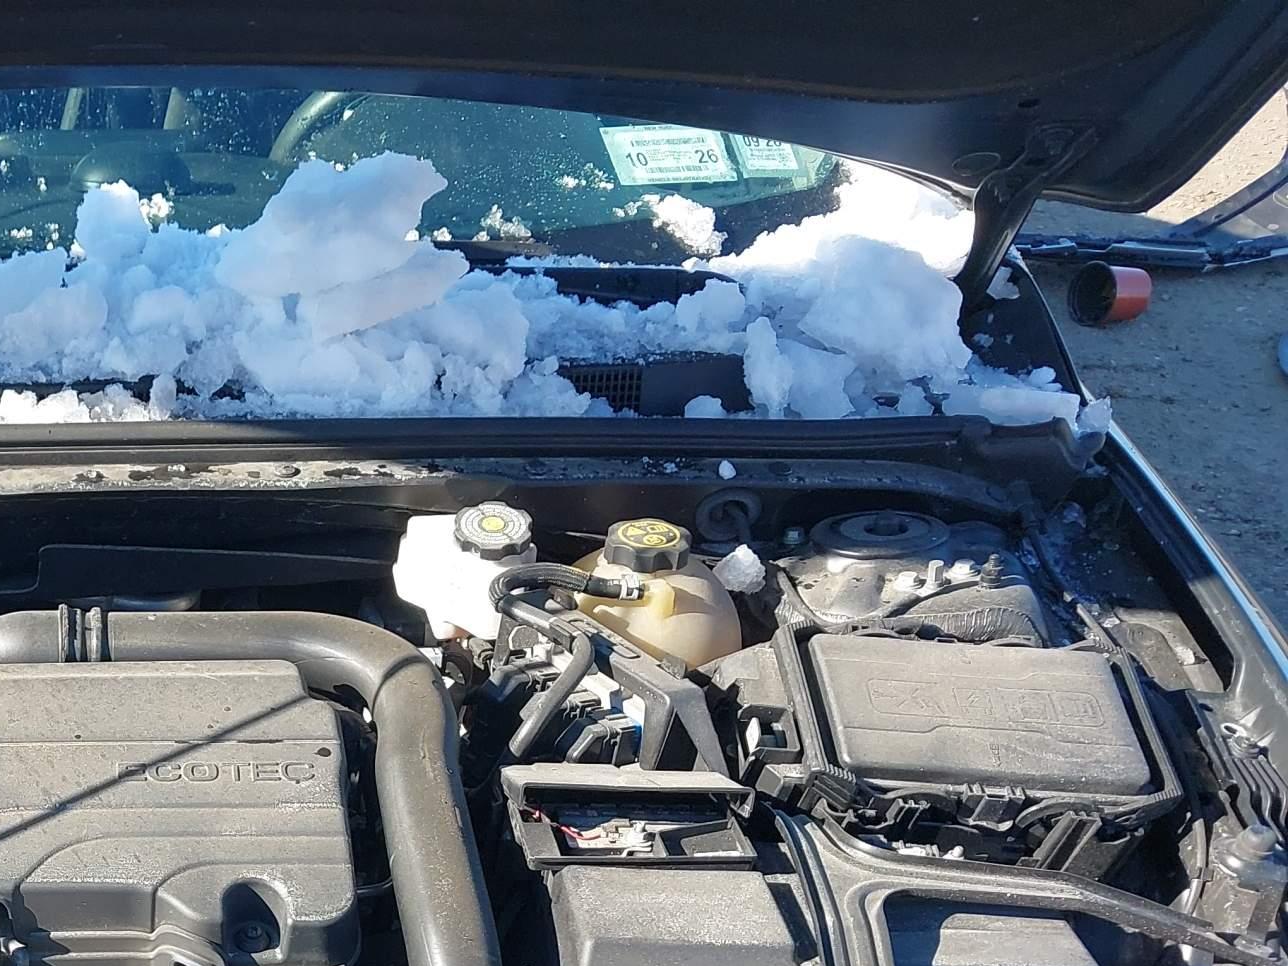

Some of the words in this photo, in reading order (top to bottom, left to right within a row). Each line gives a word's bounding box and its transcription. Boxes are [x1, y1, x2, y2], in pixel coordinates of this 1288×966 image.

[625, 151, 648, 168] 10
[694, 149, 718, 164] 26
[116, 761, 316, 783] ECOTEC
